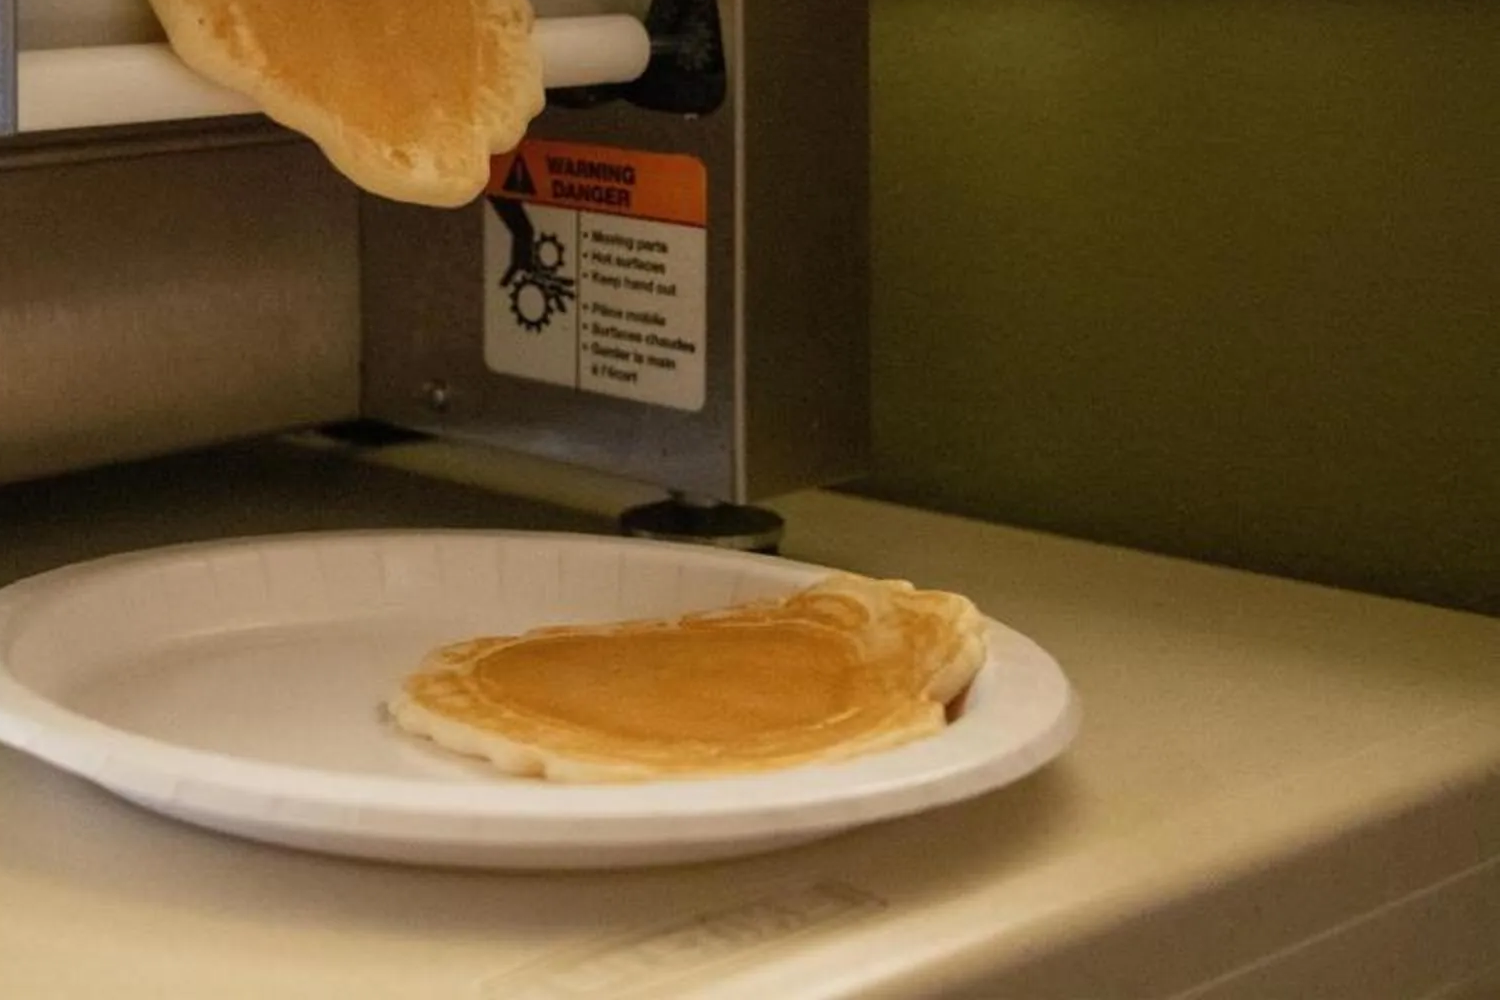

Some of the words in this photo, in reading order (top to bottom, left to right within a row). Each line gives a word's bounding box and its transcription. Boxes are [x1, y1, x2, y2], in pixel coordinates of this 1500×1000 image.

[546, 156, 635, 186] WARNING
[552, 179, 630, 208] DANGER
[591, 230, 634, 252] Moving
[636, 239, 668, 254] parts
[591, 250, 612, 265] Hot
[615, 256, 666, 275] surfaces
[591, 270, 622, 290] Keep
[656, 283, 676, 297] out
